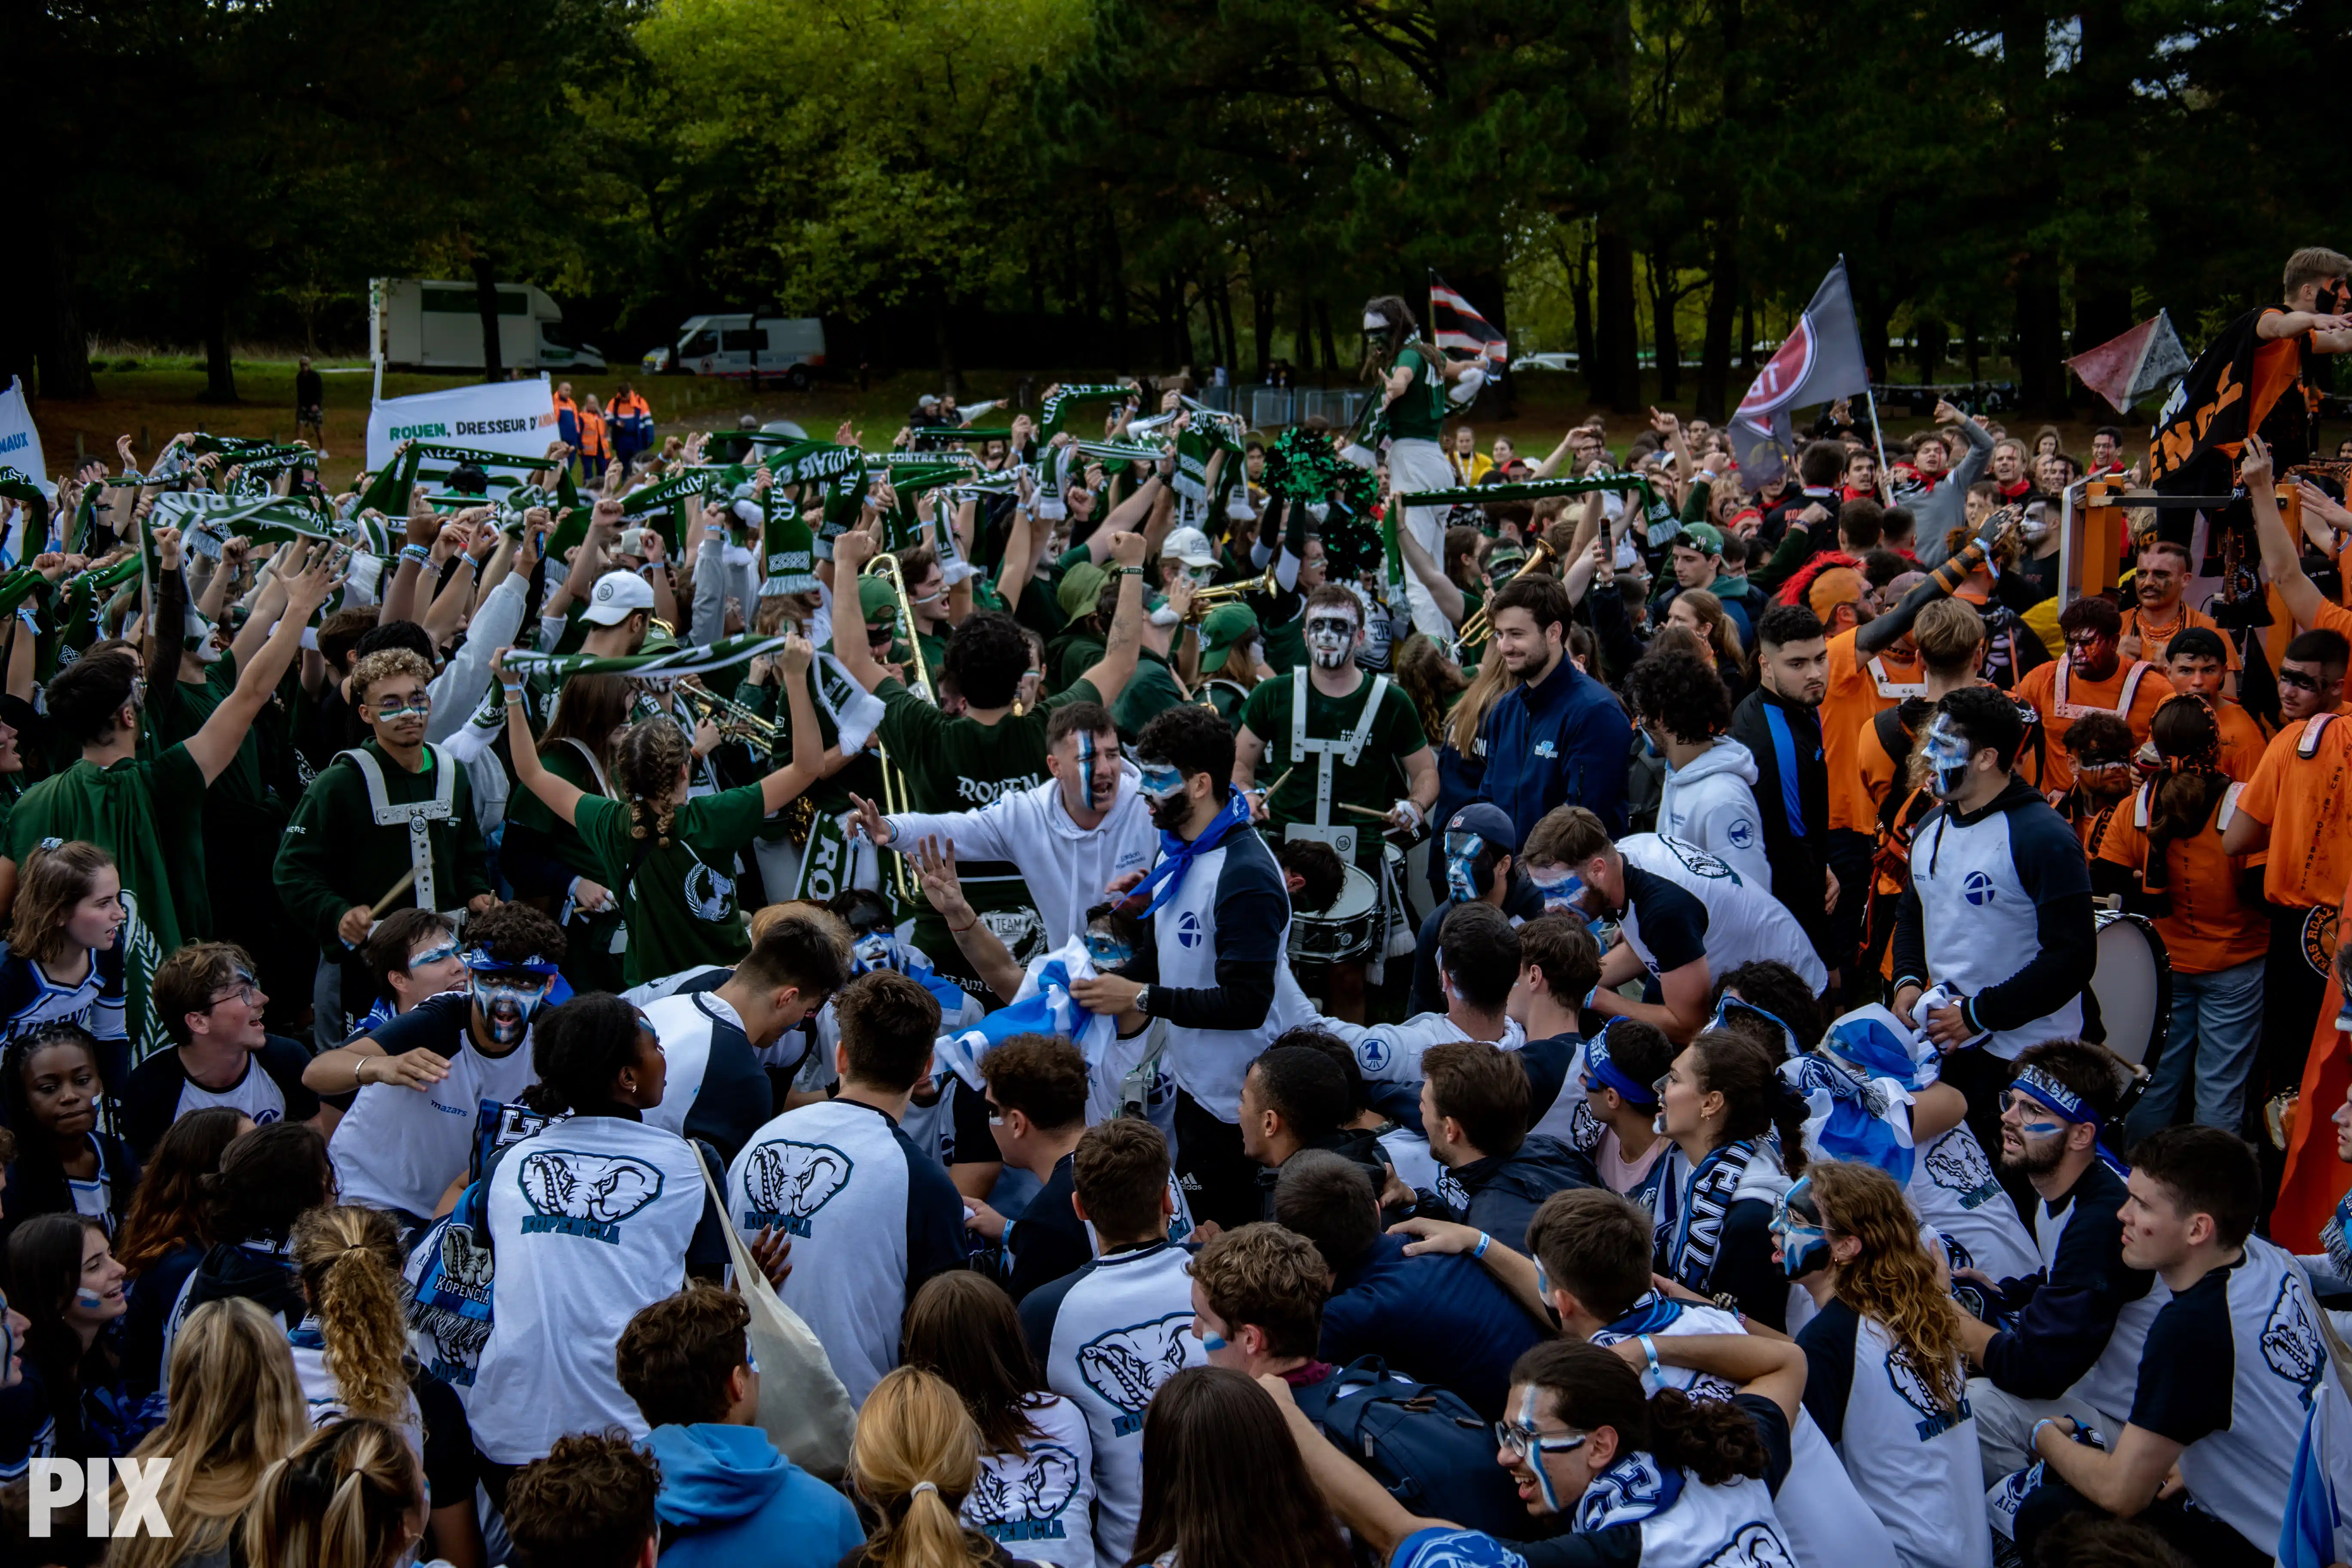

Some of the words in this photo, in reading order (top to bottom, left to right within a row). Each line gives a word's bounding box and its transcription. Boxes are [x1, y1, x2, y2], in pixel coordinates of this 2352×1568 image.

[390, 423, 451, 441] ROUEN,
[456, 419, 526, 436] DRESSEUR
[887, 452, 937, 463] CONTRE
[1697, 535, 1707, 545] 16
[2331, 766, 2343, 789] FEU
[2323, 798, 2331, 813] ET
[2315, 821, 2323, 837] DE
[996, 918, 1021, 931] TEAM
[431, 1099, 468, 1117] mazars
[520, 1215, 621, 1246] KOPENCIA
[434, 1273, 491, 1305] KOPENCIA
